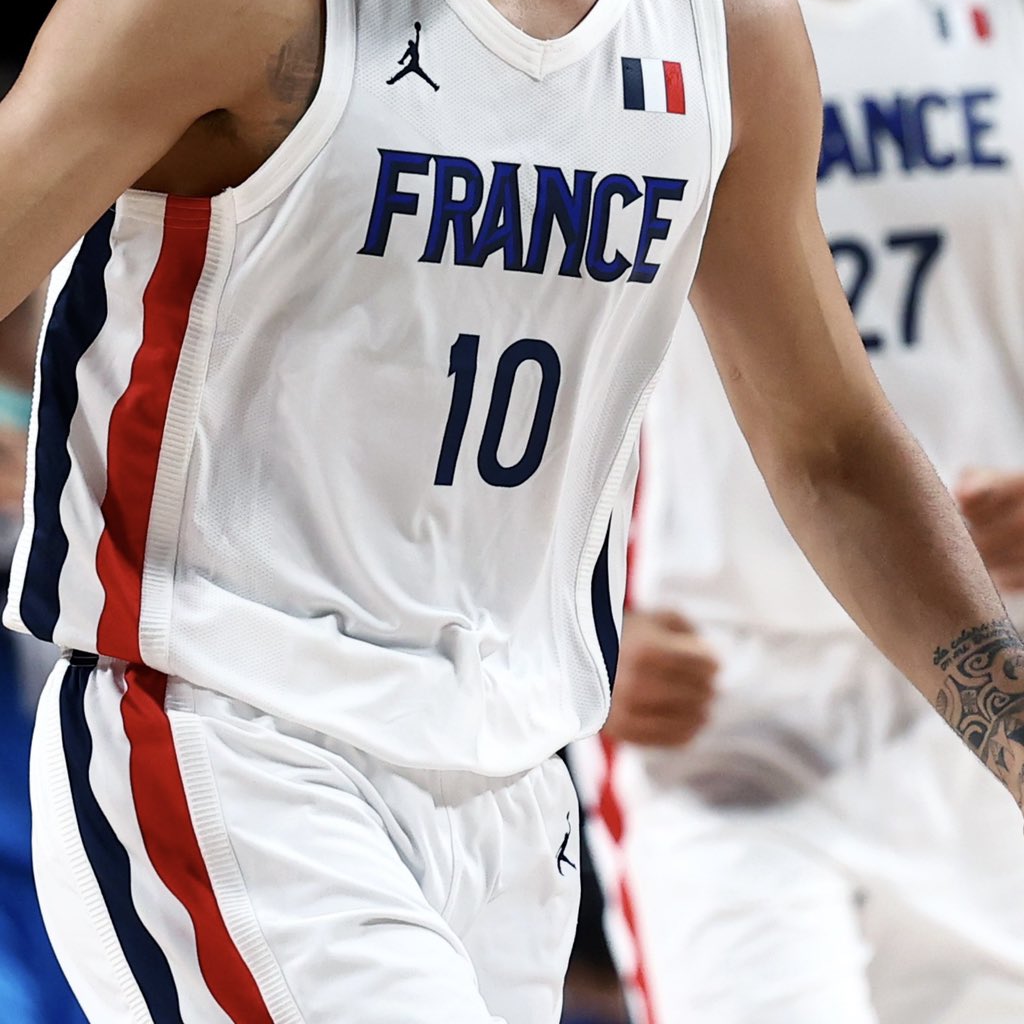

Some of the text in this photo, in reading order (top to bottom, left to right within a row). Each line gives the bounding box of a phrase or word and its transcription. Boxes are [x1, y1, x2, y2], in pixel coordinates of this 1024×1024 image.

[817, 88, 1007, 181] ANCE
[356, 148, 689, 284] FRANCE
[829, 231, 944, 351] 27
[433, 333, 562, 488] 10
